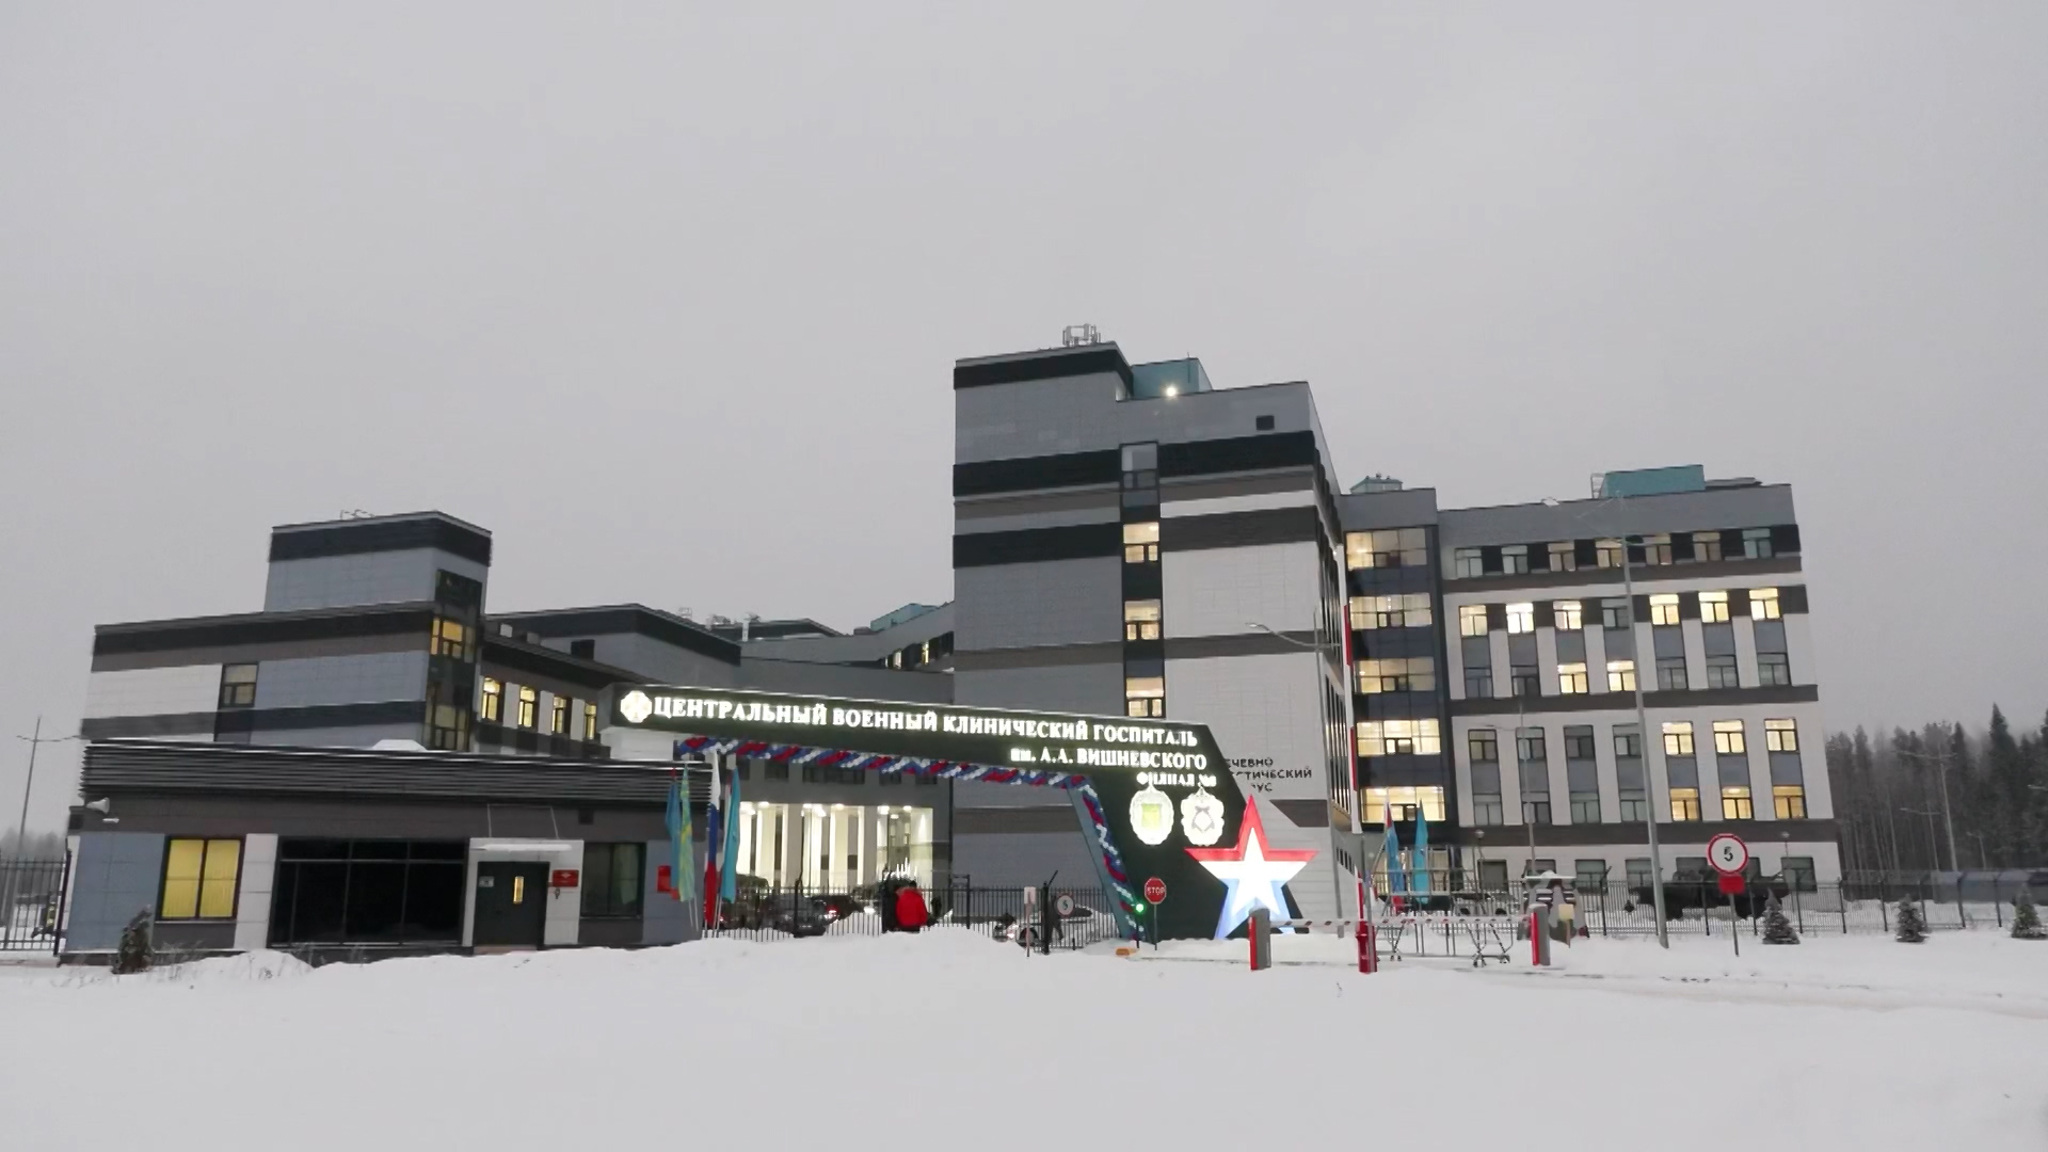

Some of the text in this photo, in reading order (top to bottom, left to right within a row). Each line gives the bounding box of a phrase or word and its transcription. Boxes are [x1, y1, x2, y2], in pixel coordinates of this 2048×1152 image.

[654, 696, 1198, 747] ЦЕНТРАЛЬНЫЙ ВОЕННЫЙ КЛИНИЧЕСКИЙ ГОСПИТАЛЬ
[1076, 749, 1207, 770] ВИШНЕВСКОГО
[1723, 845, 1734, 862] 5
[1147, 886, 1165, 895] STOP
